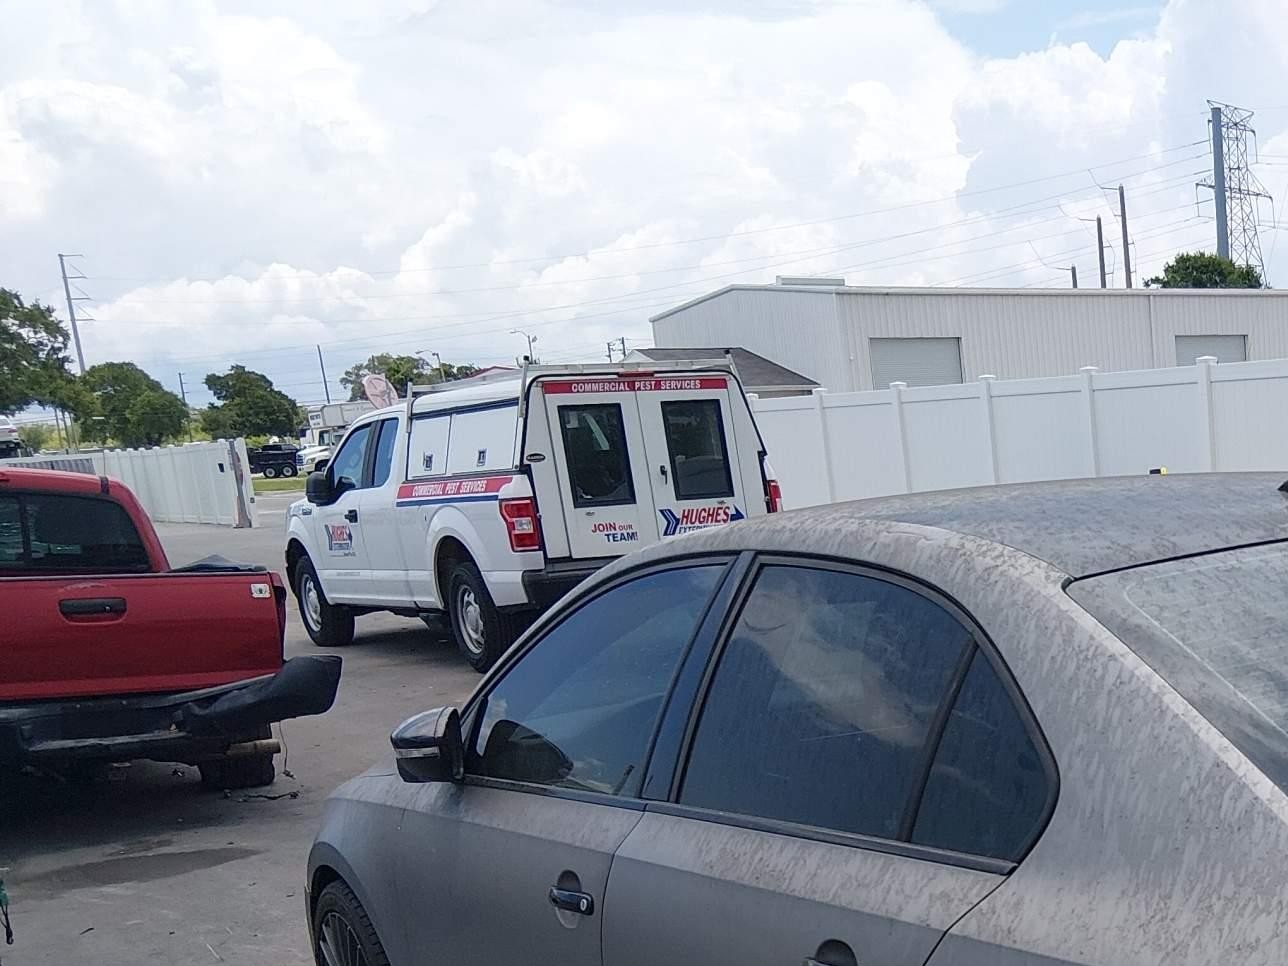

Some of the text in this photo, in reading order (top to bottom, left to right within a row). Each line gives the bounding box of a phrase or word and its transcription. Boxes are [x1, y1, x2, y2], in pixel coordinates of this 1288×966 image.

[571, 379, 701, 393] COMMERCIAL PEST SERVICES
[412, 480, 487, 497] COMMERCIAL PEST SERVICES
[679, 506, 731, 526] HUGHES
[591, 522, 617, 533] JOIN
[604, 532, 639, 543] TEAM!
